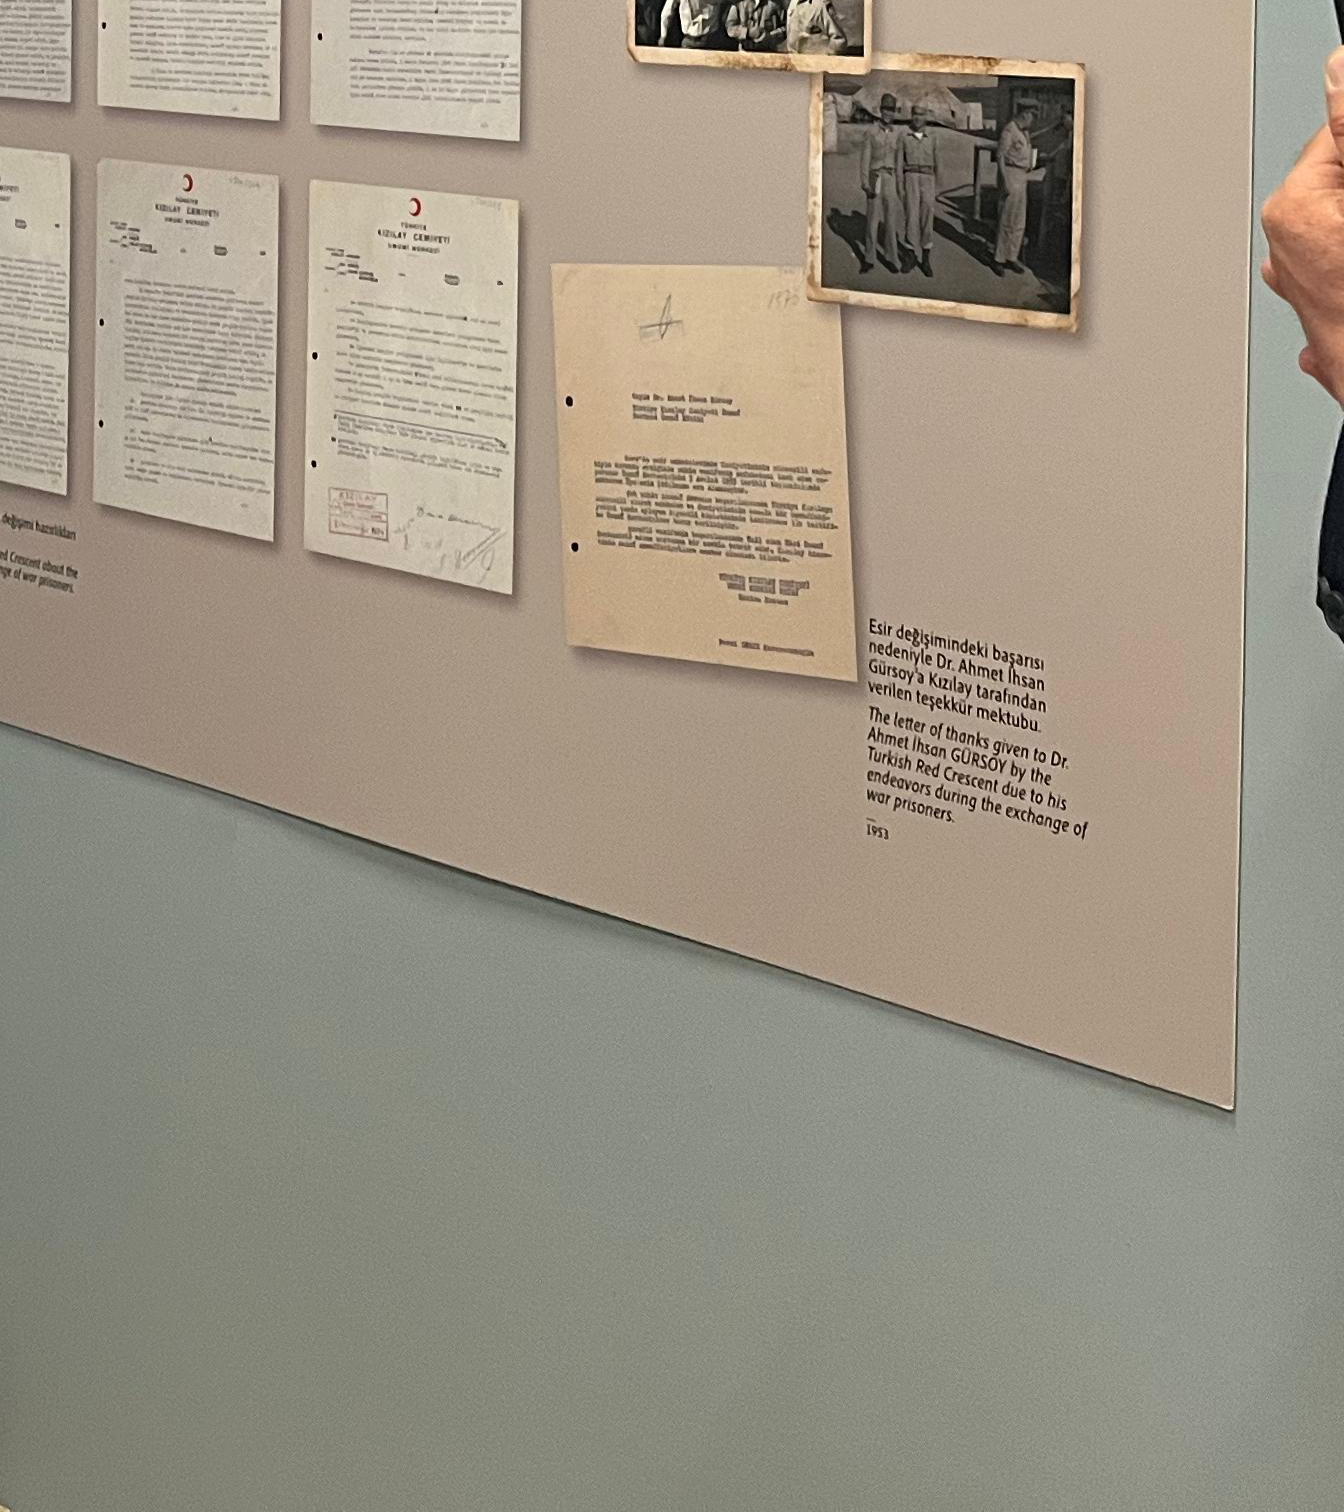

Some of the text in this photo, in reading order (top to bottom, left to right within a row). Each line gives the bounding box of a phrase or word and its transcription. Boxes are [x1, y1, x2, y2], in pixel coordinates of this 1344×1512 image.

[869, 618, 1045, 671] Esir değişimindeki başarısı
[869, 640, 1045, 691] nedeniyle Dr. Ahmet İhsan
[868, 681, 1041, 732] verilen teşekkür mektubu.
[929, 672, 972, 698] Kızılay
[977, 685, 1046, 713] tarafından
[867, 727, 1052, 786] Ahmet İhsan GÜRSOY by the
[869, 706, 1069, 769] The letter of thanks given to Dr.
[867, 769, 1089, 840] endeavors during the exchange of
[869, 746, 1067, 811] Turkish Red Crescent due to his
[867, 789, 955, 823] war prisoners.
[866, 825, 889, 840] 1953
